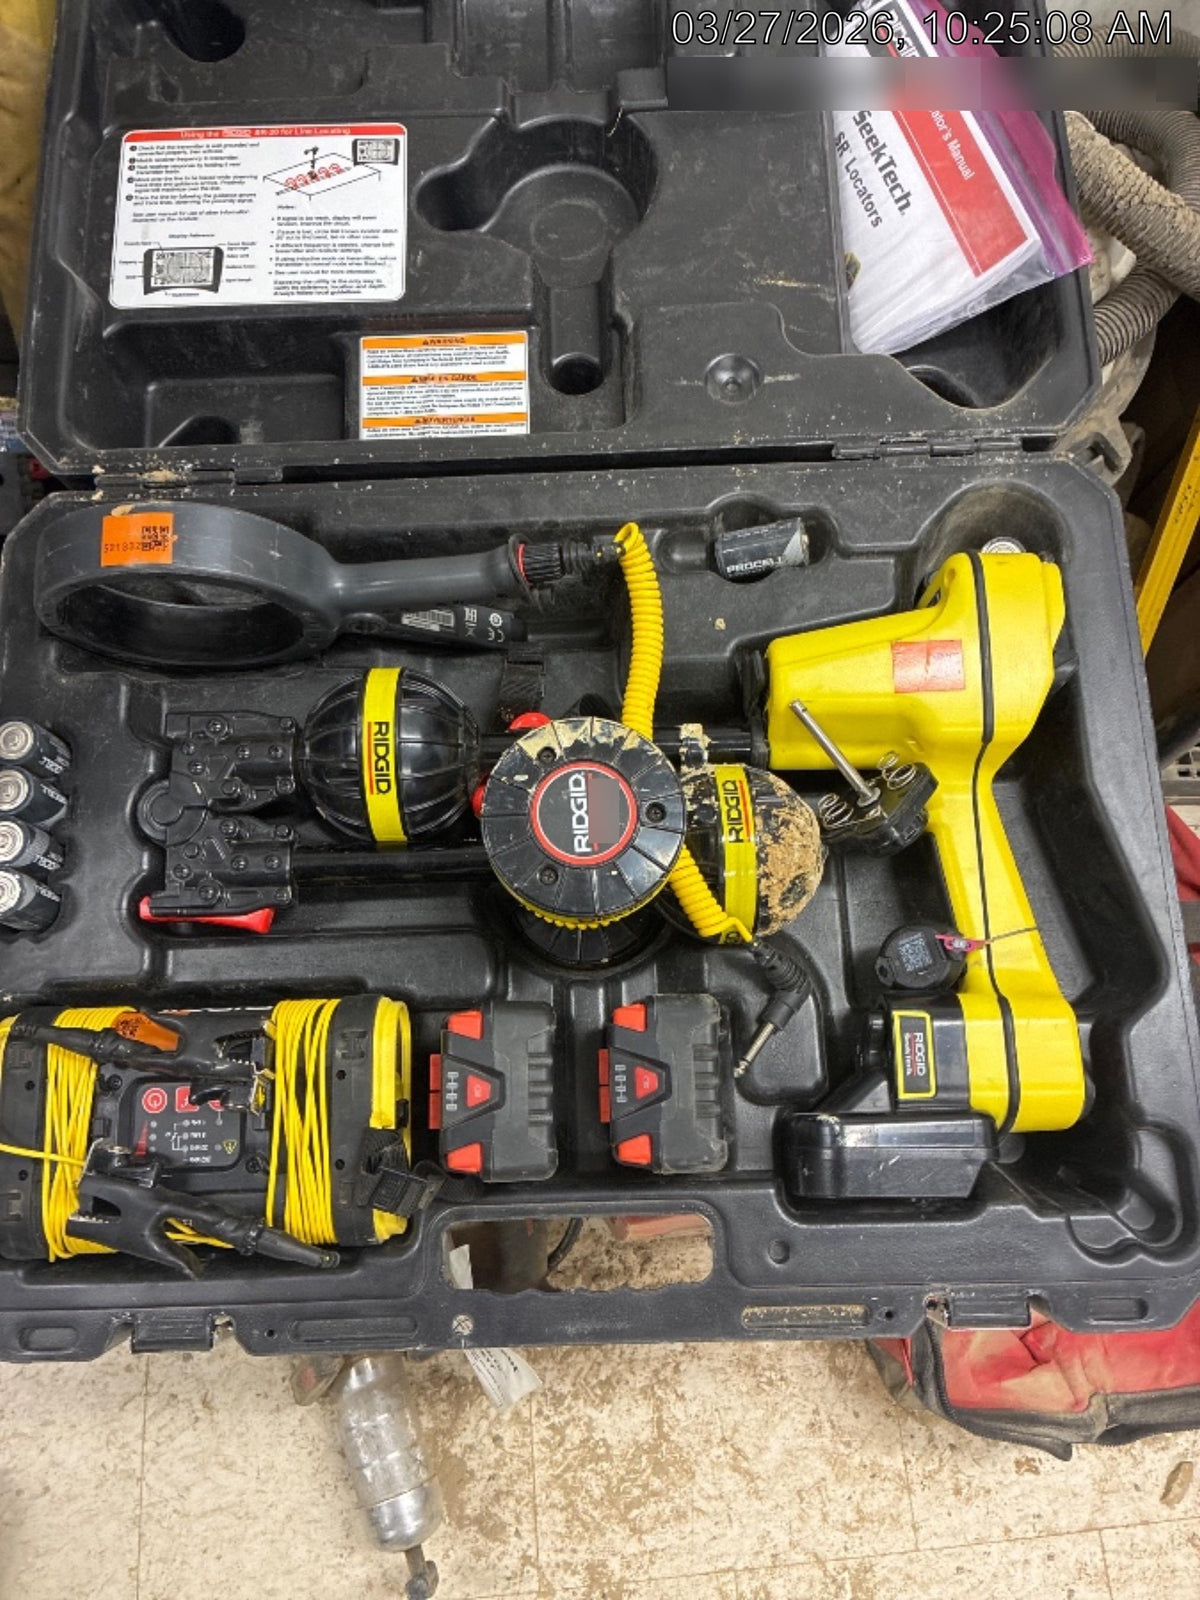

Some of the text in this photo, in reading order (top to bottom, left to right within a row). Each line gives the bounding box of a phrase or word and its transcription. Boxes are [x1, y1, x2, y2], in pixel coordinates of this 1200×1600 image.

[844, 157, 882, 229] Locators
[946, 139, 975, 181] Manual
[374, 721, 391, 794] RIDGID
[569, 771, 592, 852] RIDGID
[722, 780, 744, 843] RIDGID
[913, 1032, 926, 1077] RIDGID
